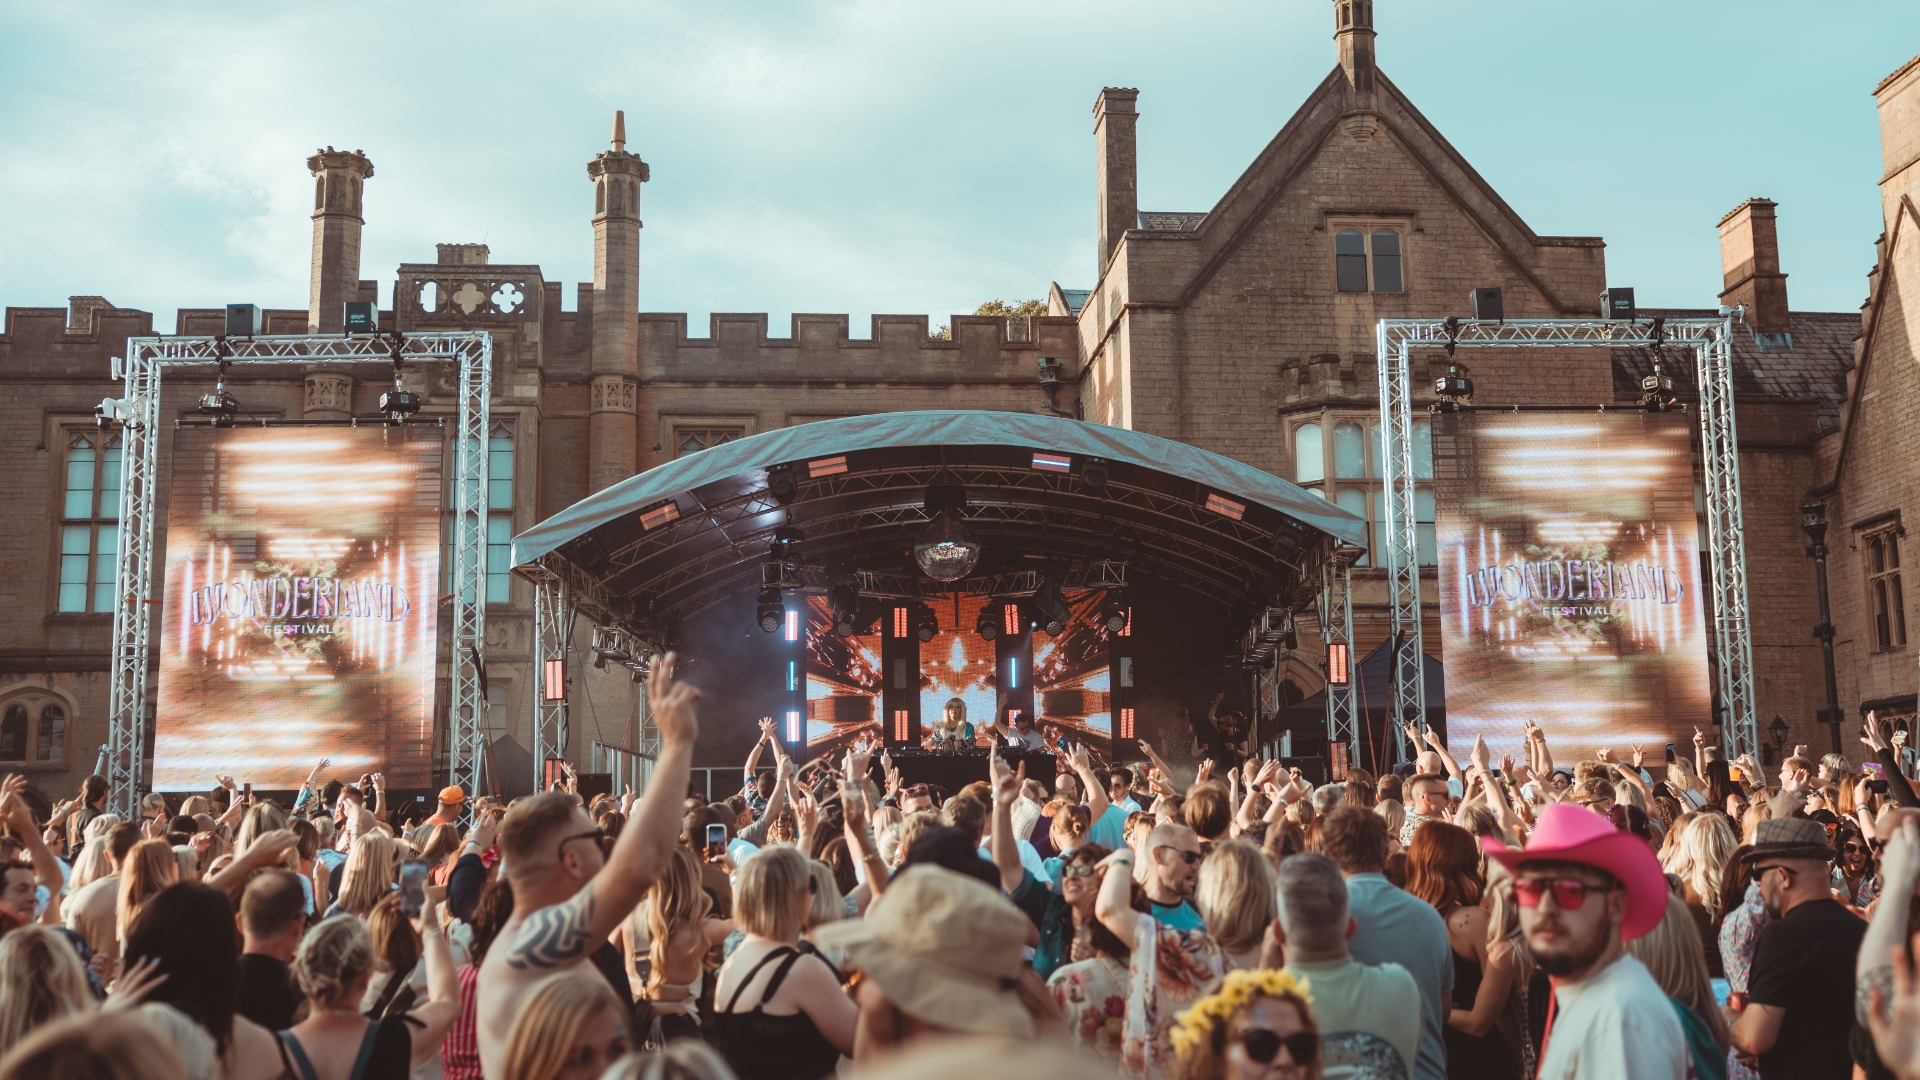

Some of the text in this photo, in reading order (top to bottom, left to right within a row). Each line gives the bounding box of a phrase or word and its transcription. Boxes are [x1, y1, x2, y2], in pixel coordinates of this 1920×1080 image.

[1466, 559, 1684, 607] WONDERLAND
[191, 576, 410, 624] WONDERLAND
[1542, 606, 1611, 616] FESTIVAL
[263, 624, 334, 634] FESTIVAL
